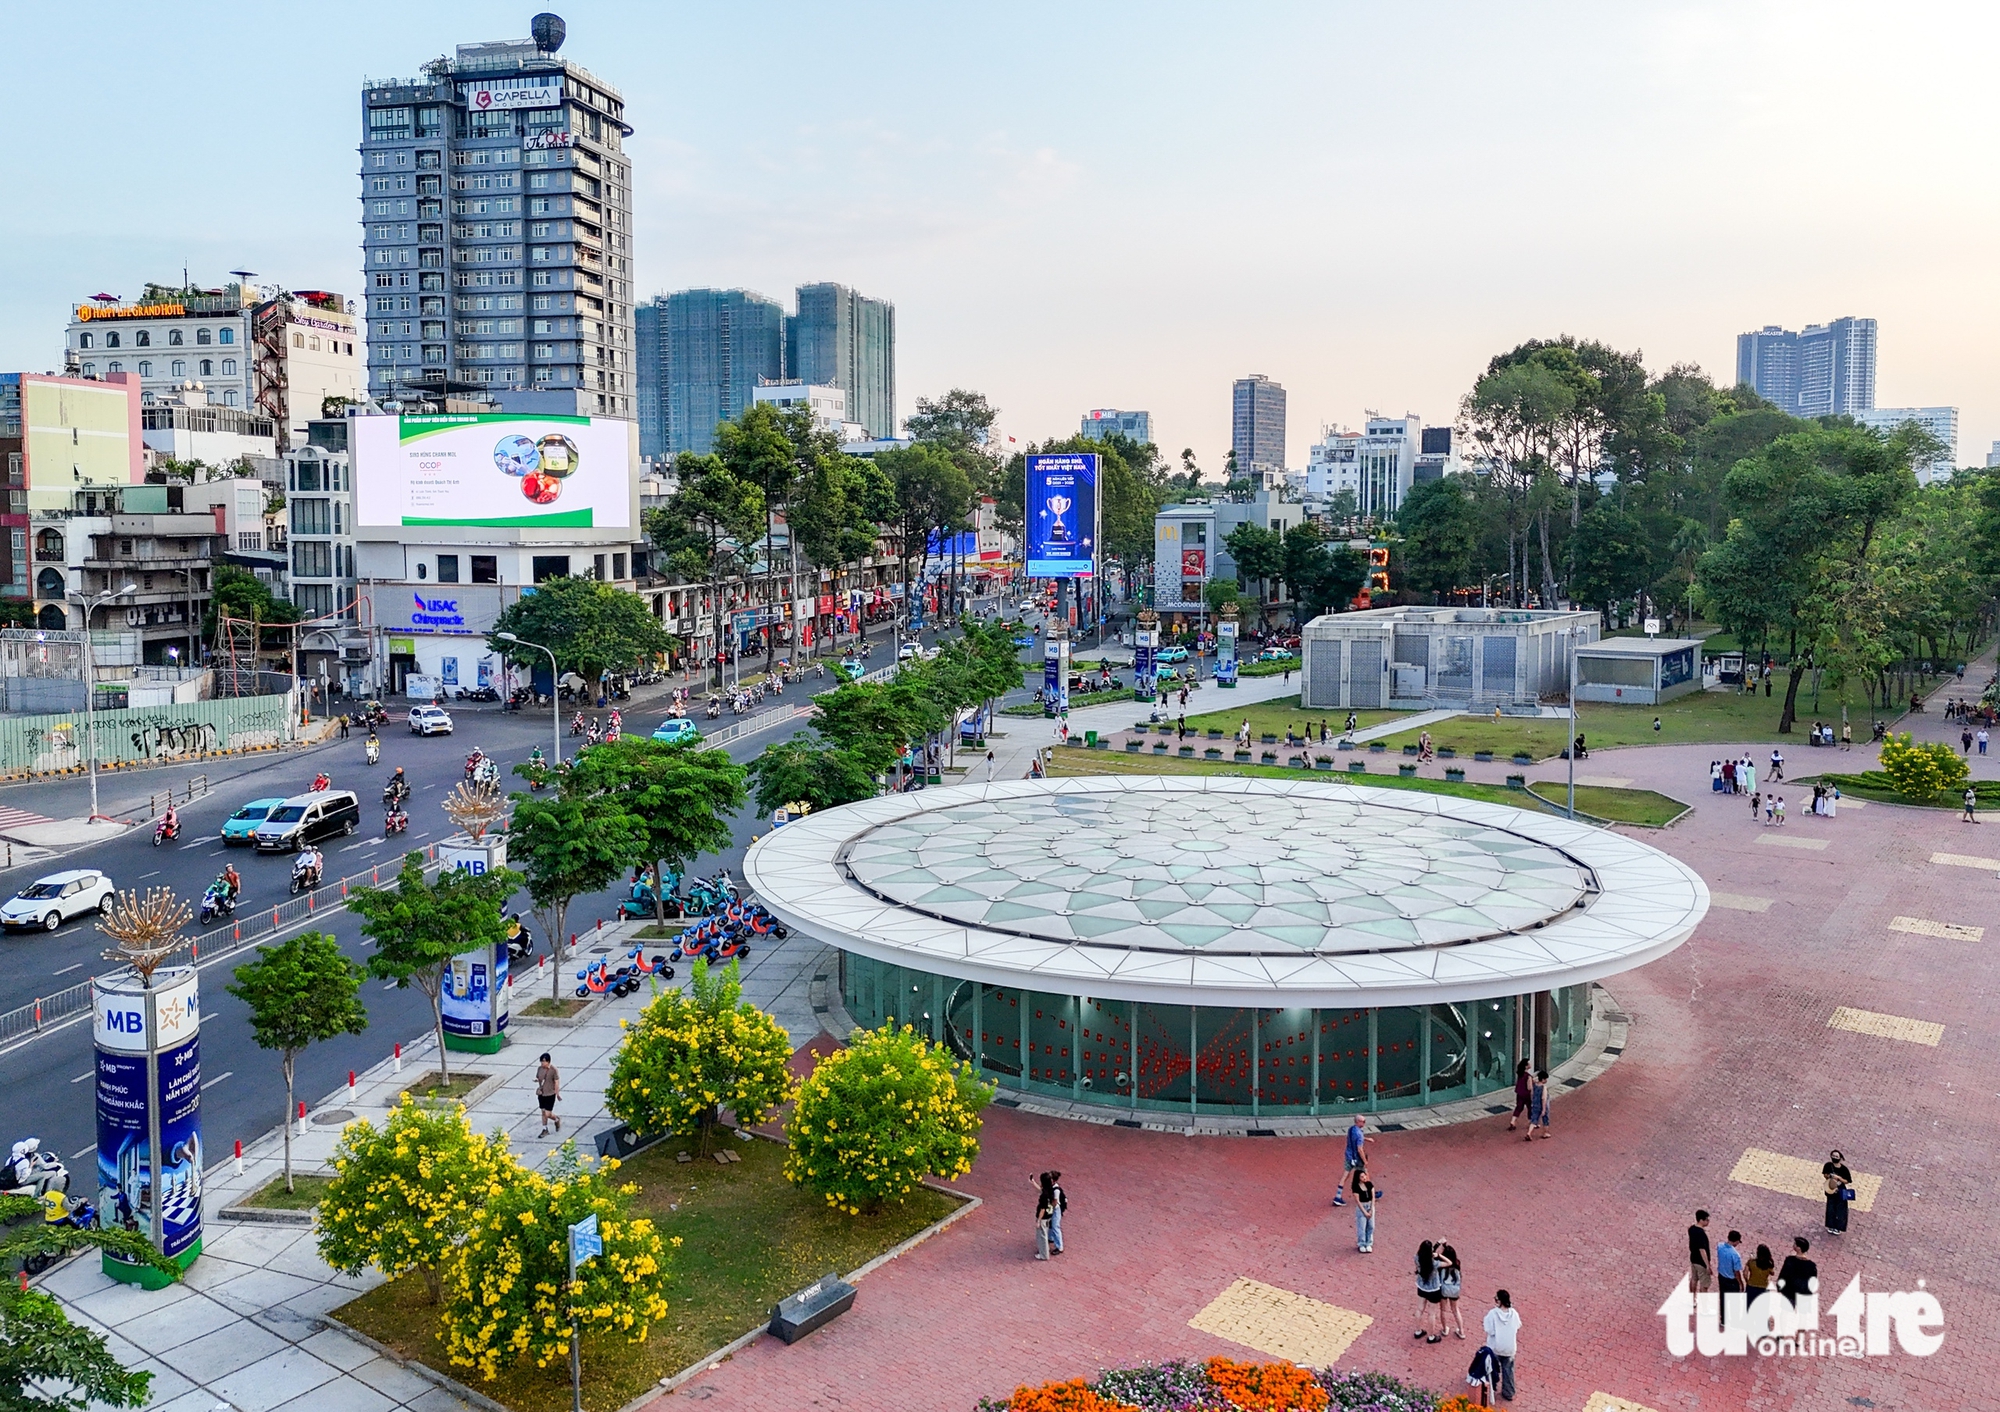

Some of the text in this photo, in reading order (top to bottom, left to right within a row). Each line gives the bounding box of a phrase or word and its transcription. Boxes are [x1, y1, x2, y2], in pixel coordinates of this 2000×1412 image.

[494, 90, 551, 101] CAPELLA
[546, 132, 570, 144] ONE
[132, 304, 161, 317] GRAND
[161, 303, 185, 315] HOTEL
[419, 461, 442, 469] OCOP
[1046, 477, 1052, 486] 5
[1048, 646, 1058, 654] MB
[456, 860, 486, 877] MB
[107, 1009, 143, 1034] MB
[106, 1063, 117, 1074] MB
[169, 1079, 182, 1089] LÀM
[112, 1085, 128, 1095] PHÚC
[125, 1099, 145, 1110] KHẮC
